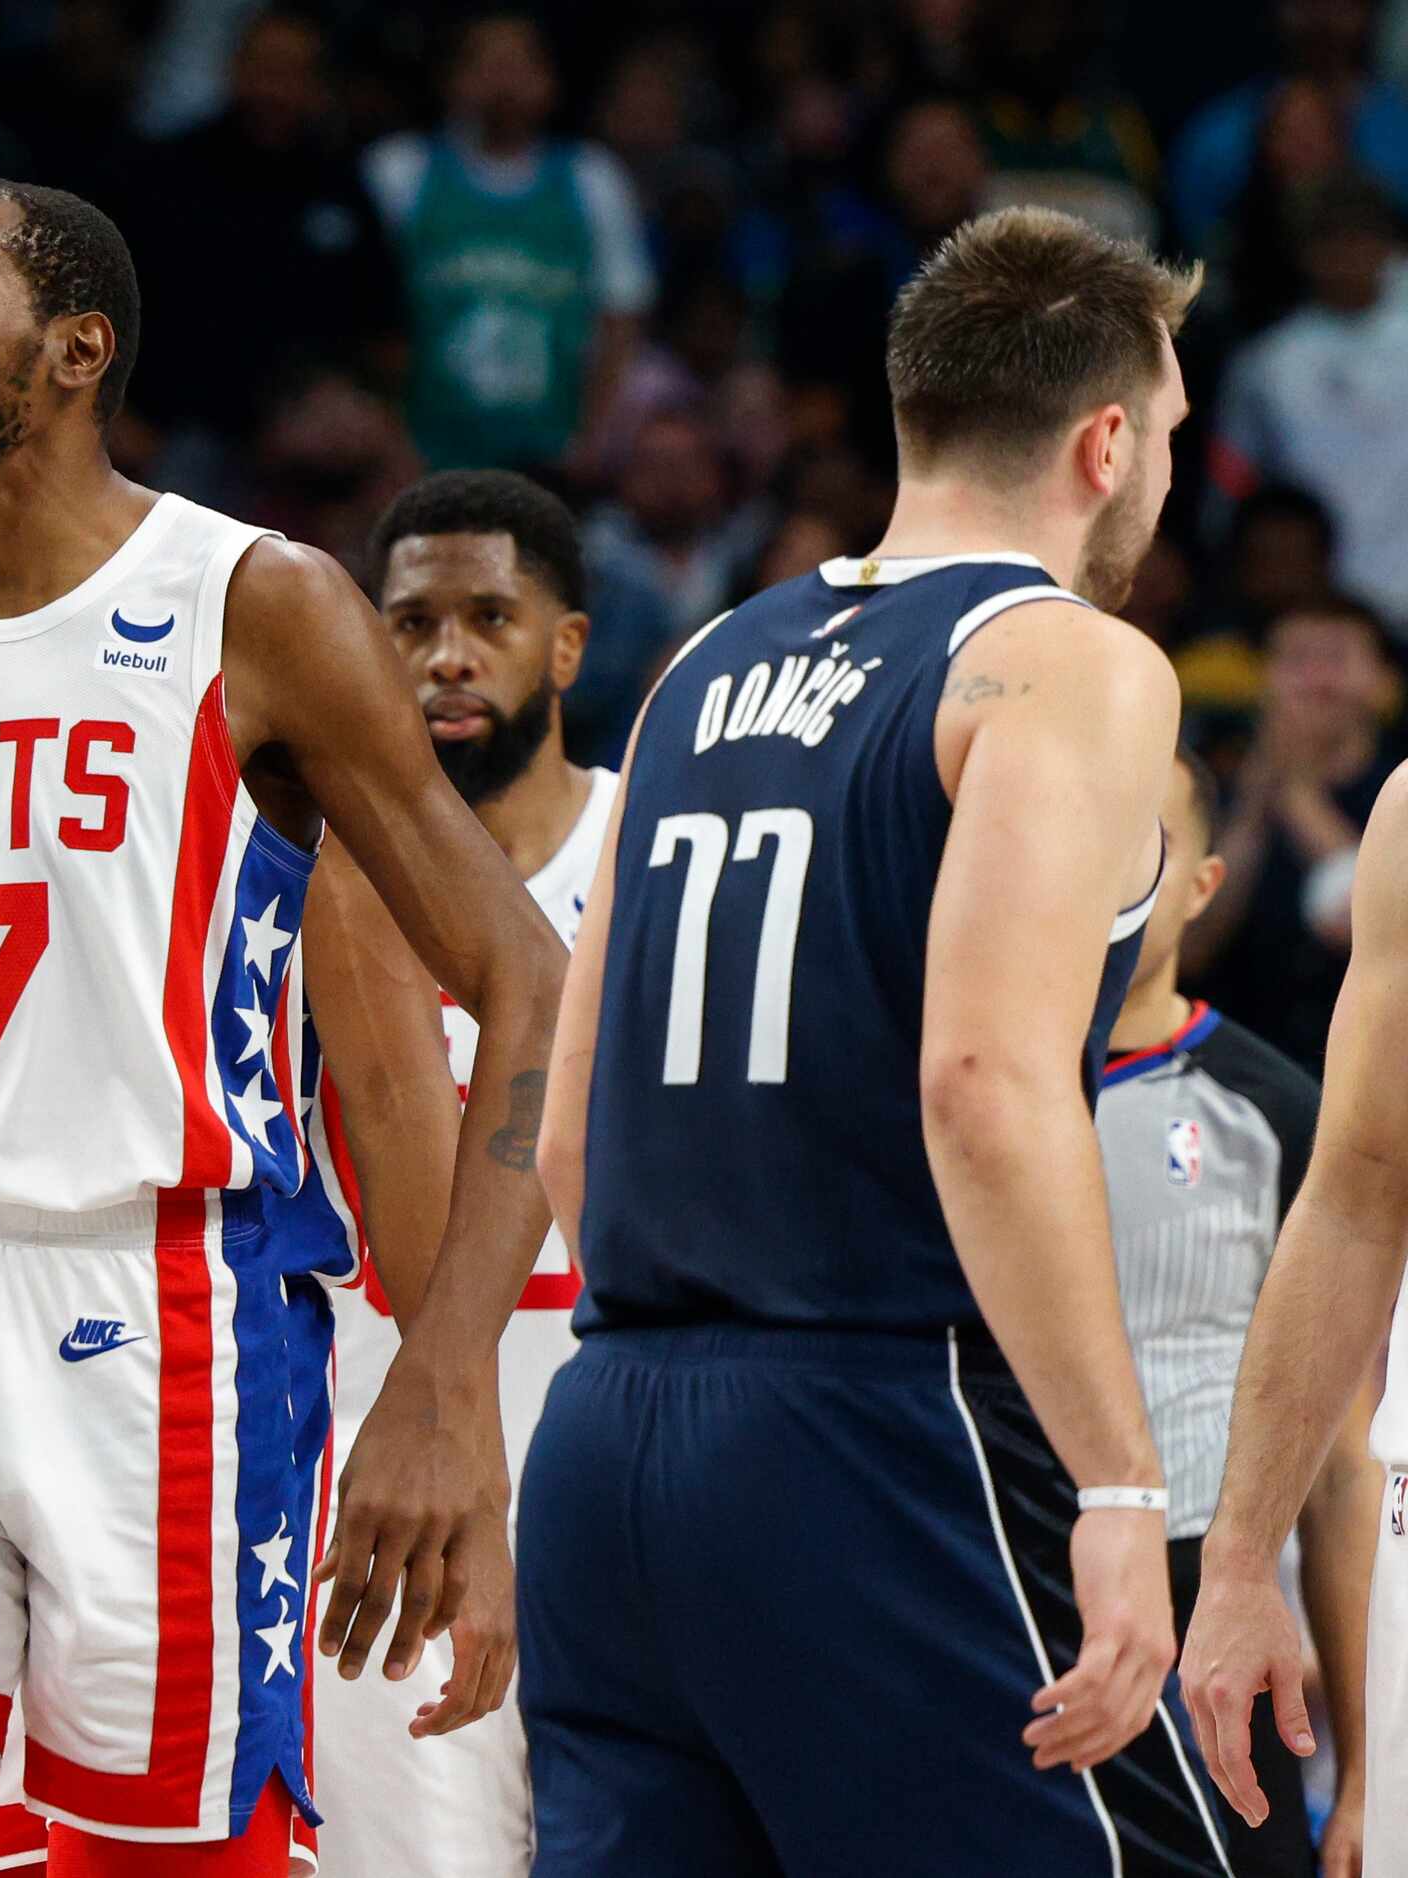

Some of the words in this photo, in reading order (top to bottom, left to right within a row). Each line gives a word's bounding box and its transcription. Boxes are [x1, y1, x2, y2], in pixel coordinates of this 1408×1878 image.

[103, 649, 167, 672] Webull
[695, 641, 882, 755] DONČIĆ
[648, 807, 814, 1085] 77
[71, 1318, 126, 1345] NIKE
